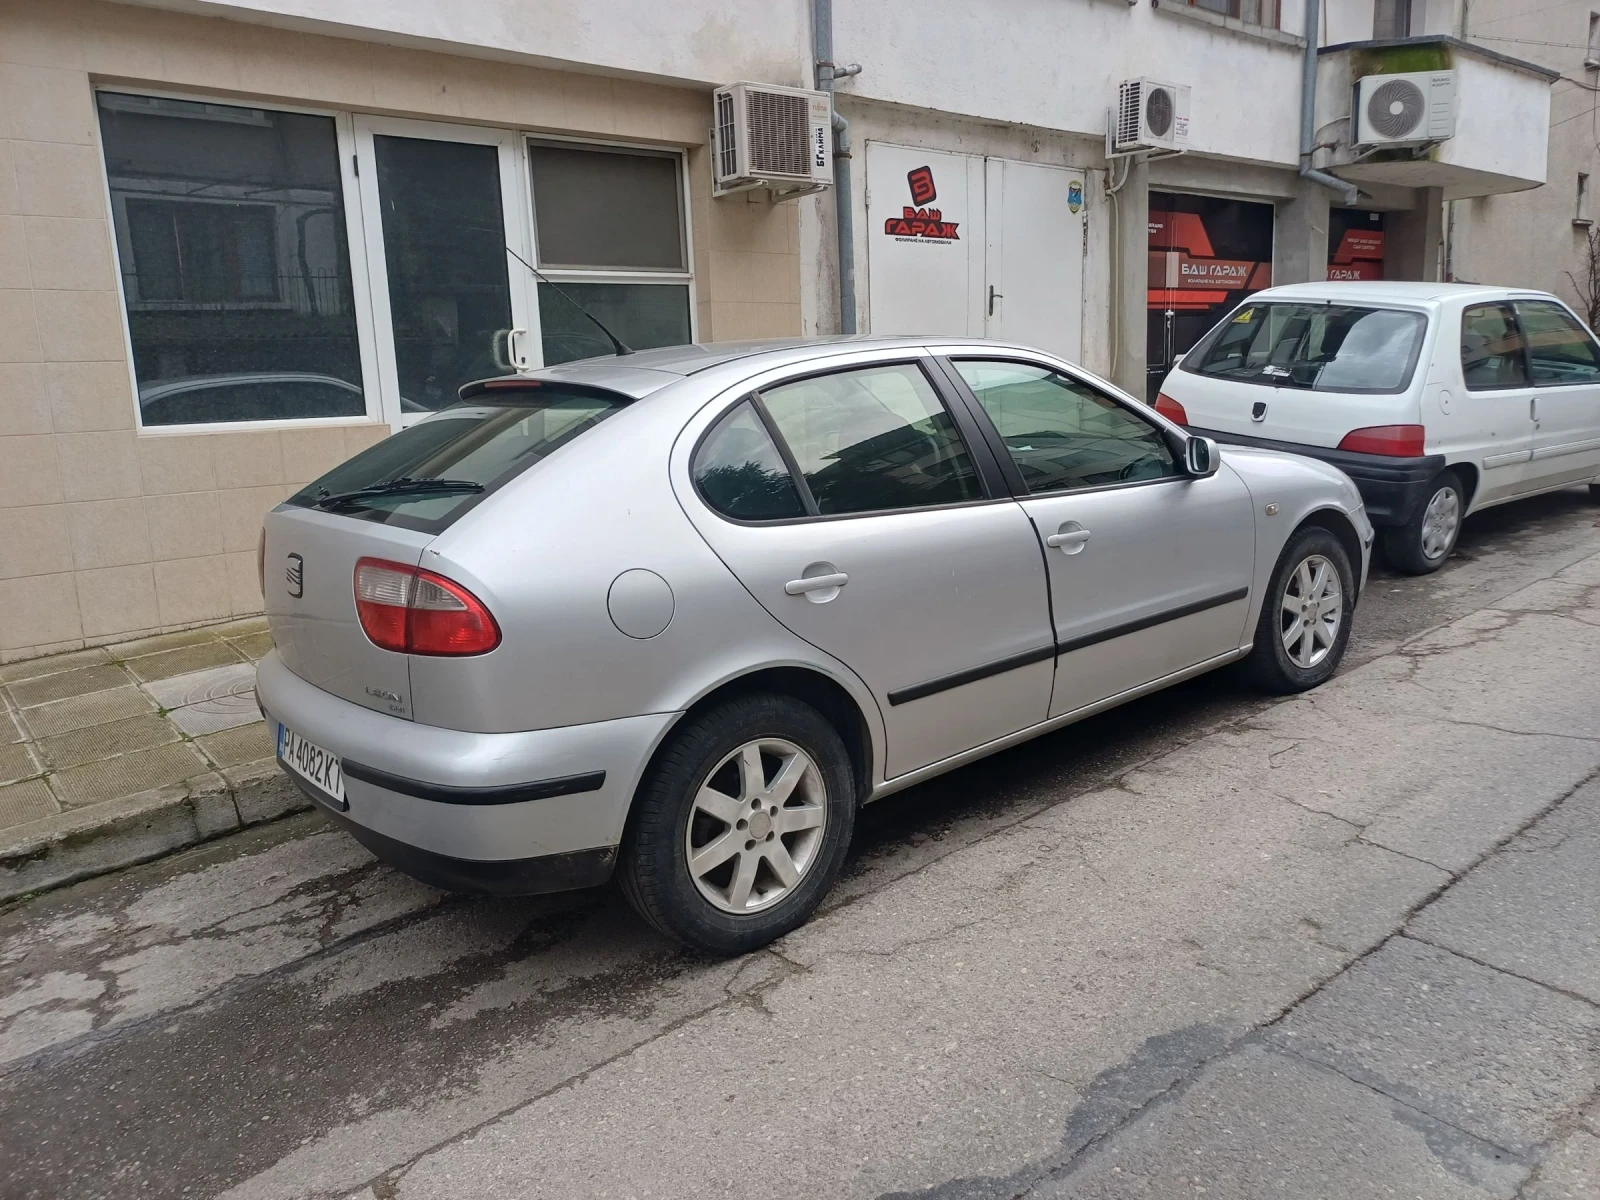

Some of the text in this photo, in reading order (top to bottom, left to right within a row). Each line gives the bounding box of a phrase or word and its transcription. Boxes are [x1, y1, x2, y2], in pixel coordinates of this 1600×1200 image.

[903, 206, 942, 221] БАШ
[885, 218, 960, 240] ГАРАЖ
[1181, 263, 1247, 277] БАШ ГАРАЖ
[1330, 269, 1361, 280] ГАРАЖ
